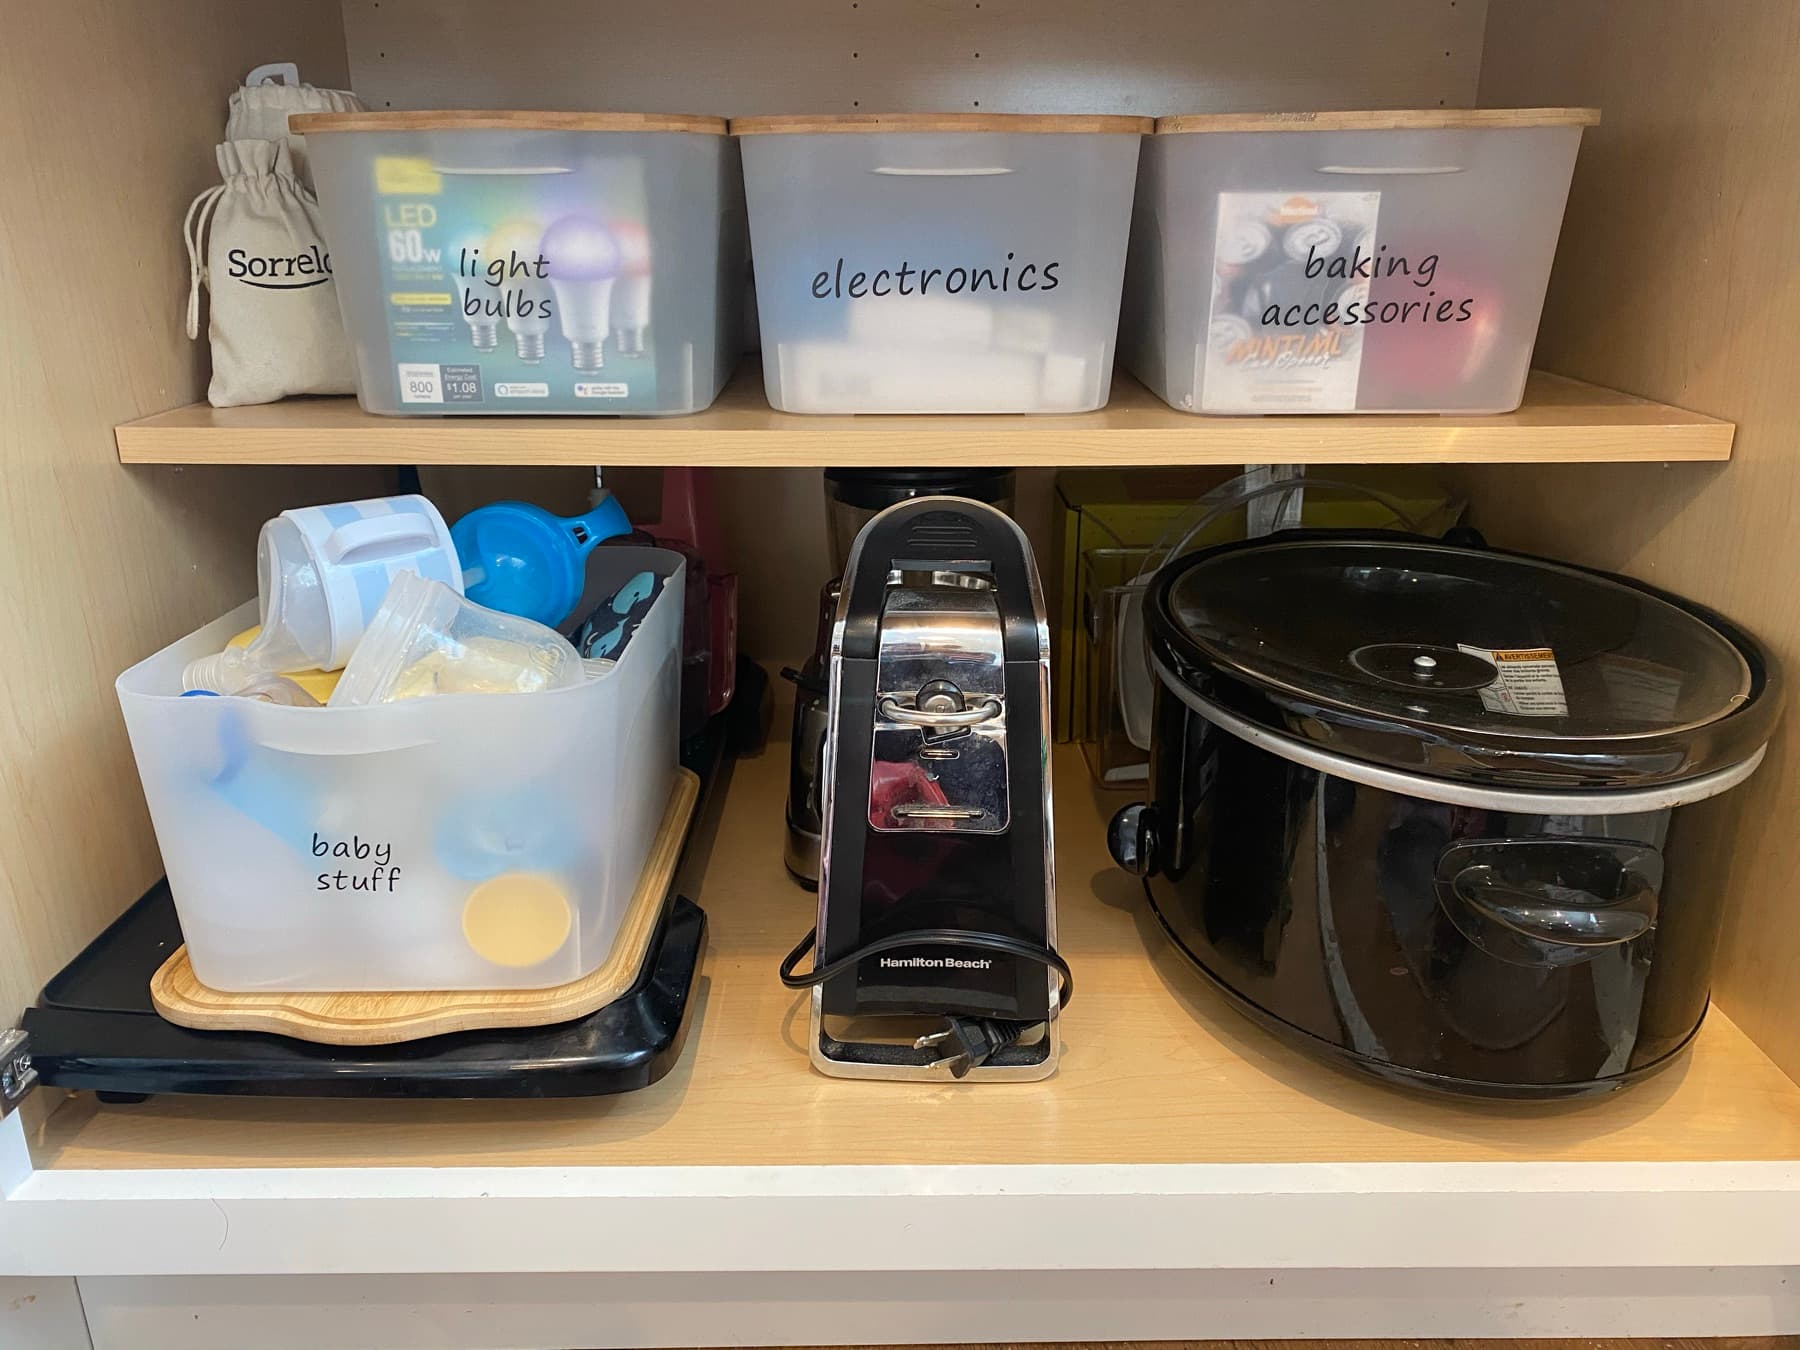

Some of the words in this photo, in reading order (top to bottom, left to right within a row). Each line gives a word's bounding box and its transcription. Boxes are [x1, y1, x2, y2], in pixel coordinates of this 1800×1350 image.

[385, 204, 437, 228] LED
[459, 247, 550, 287] light
[811, 251, 1060, 299] electronics
[1304, 244, 1440, 288] baking
[463, 287, 553, 319] bulbs
[1261, 291, 1474, 327] accessories
[409, 381, 434, 394] 800
[446, 382, 477, 394] $1.08
[312, 832, 391, 866] baby
[316, 866, 401, 892] stuff
[880, 957, 943, 968] Hamilton
[944, 957, 991, 969] Beach
